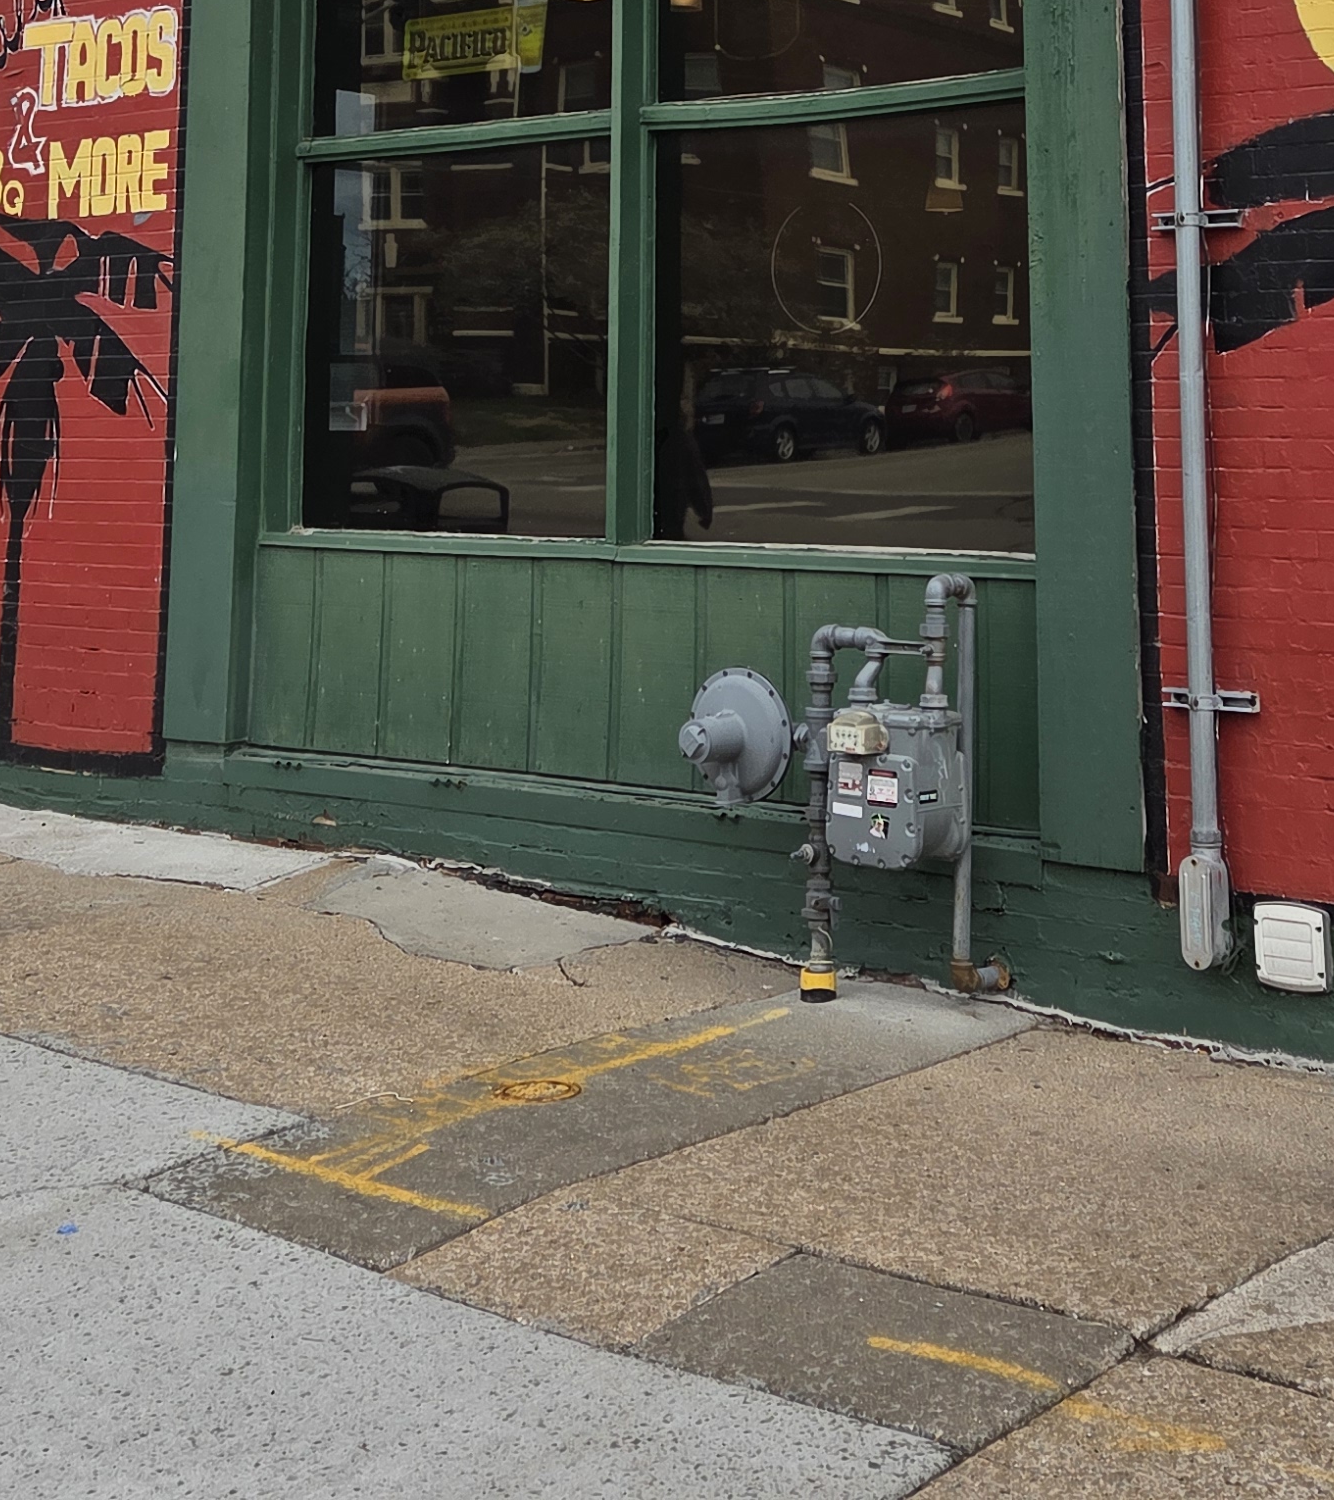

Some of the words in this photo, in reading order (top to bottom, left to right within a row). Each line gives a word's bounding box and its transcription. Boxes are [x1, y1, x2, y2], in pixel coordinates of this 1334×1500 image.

[22, 6, 177, 111] TACOS
[407, 26, 510, 70] PACIFICO
[47, 128, 171, 220] MORE
